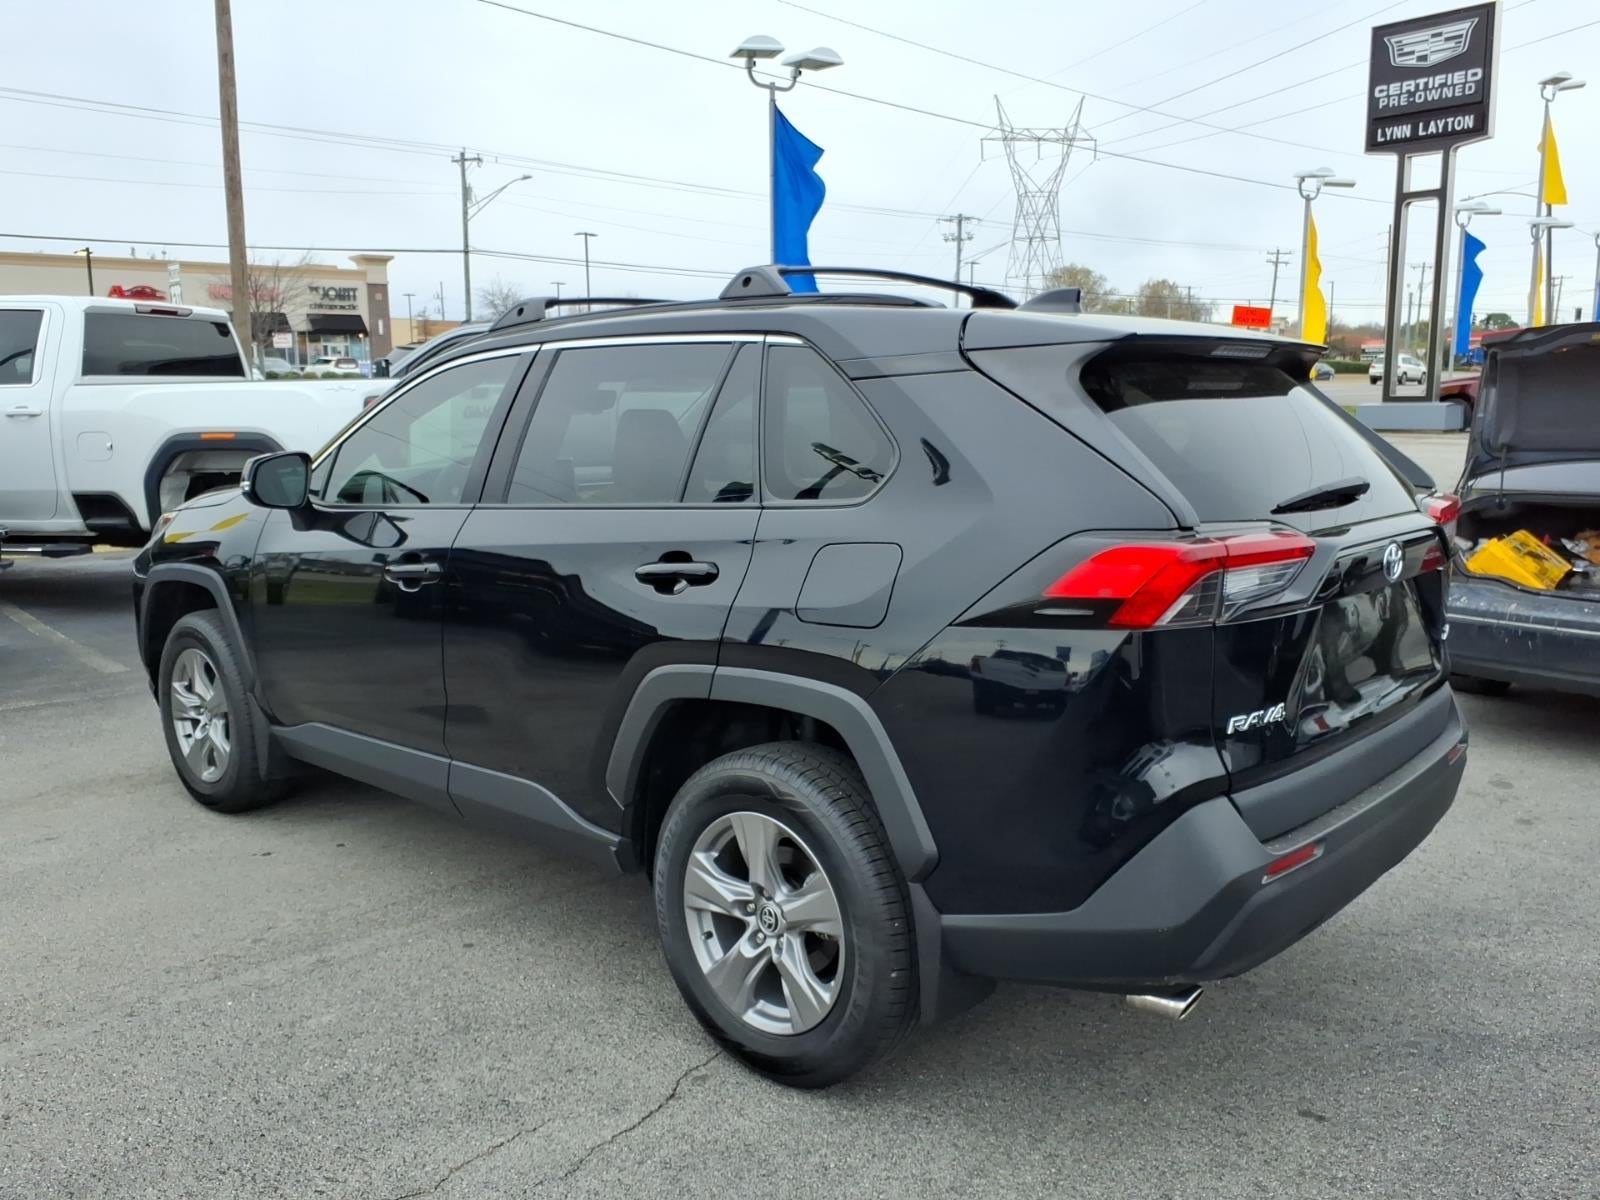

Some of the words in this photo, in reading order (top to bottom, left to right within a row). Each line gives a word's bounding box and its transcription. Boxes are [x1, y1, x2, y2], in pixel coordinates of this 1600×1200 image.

[1374, 67, 1483, 98] CERTIFIED
[1378, 82, 1476, 109] PRE-OWNED
[1376, 123, 1412, 143] LYNN
[1418, 114, 1475, 136] LAYTON
[1226, 701, 1286, 735] RAV4
